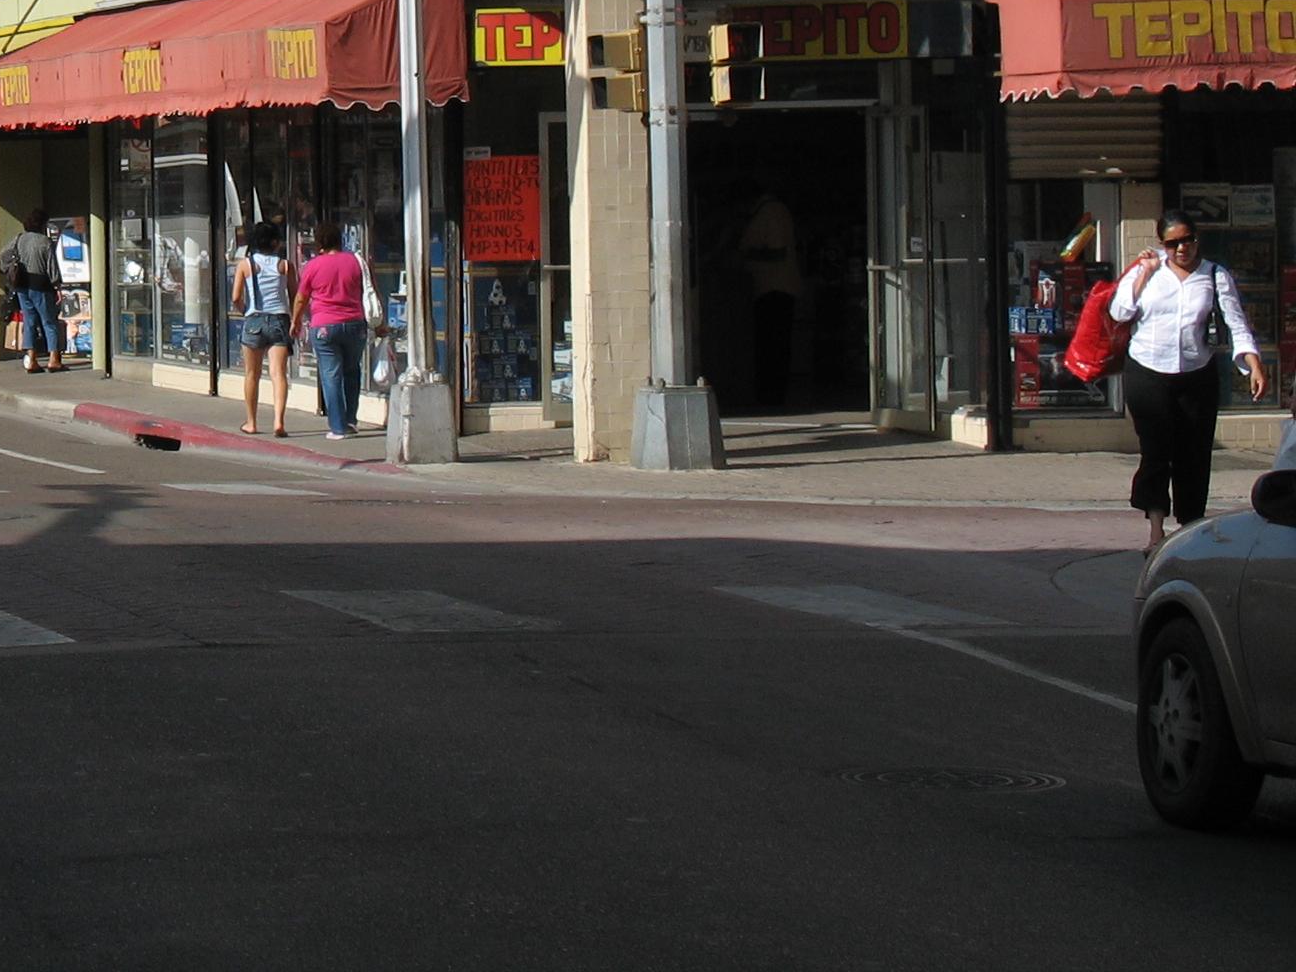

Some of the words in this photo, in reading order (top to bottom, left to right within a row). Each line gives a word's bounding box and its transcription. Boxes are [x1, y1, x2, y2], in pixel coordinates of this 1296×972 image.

[266, 28, 318, 79] TEPITO
[478, 13, 562, 61] TEP
[122, 48, 162, 94] TEPITO
